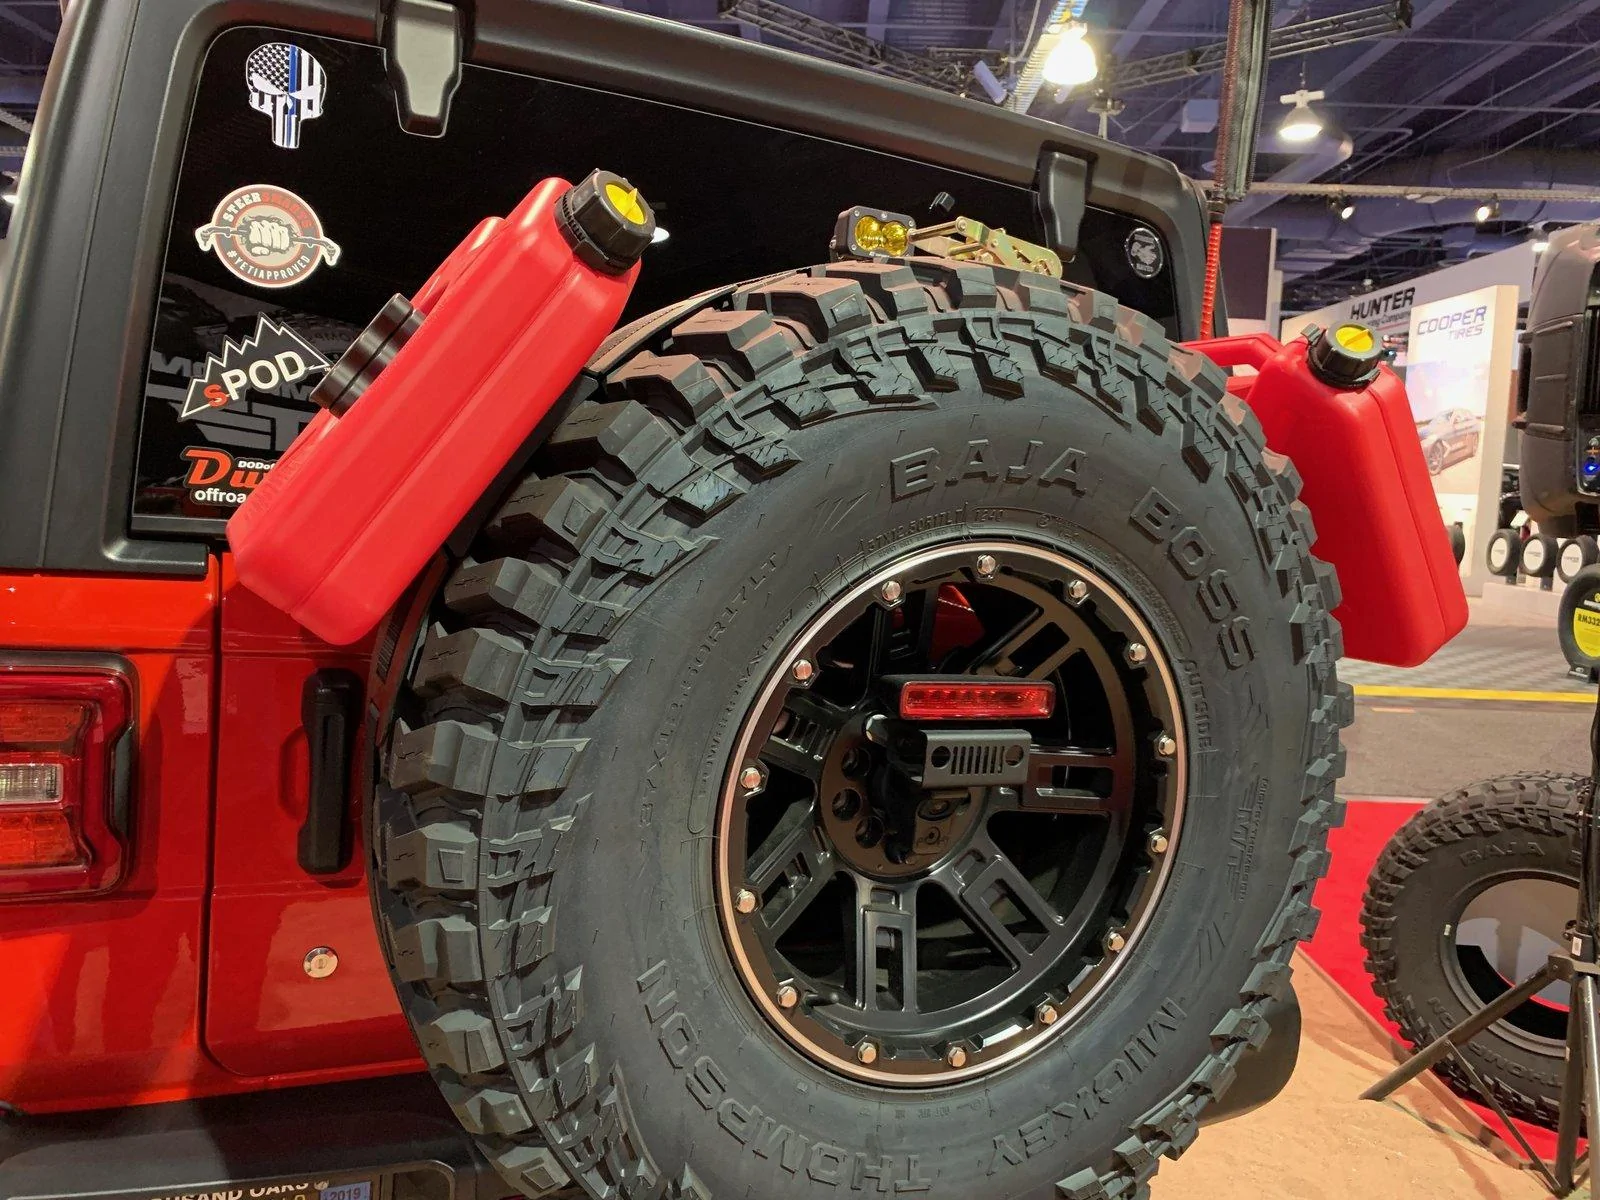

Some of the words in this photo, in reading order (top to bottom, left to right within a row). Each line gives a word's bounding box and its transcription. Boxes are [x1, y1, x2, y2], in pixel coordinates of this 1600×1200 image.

[222, 192, 262, 222] STEER
[226, 250, 311, 280] #YETIAPPROVED
[1350, 286, 1416, 321] HUNTER
[1417, 306, 1487, 336] COOPER
[1449, 324, 1484, 341] TIRES
[203, 350, 306, 407] sPOD
[194, 487, 247, 504] offroa
[890, 438, 1088, 503] BAJA
[1128, 486, 1256, 671] BOSS
[635, 958, 933, 1194] THOMPSON
[980, 996, 1188, 1177] MICKEY
[329, 1187, 361, 1200] 2019
